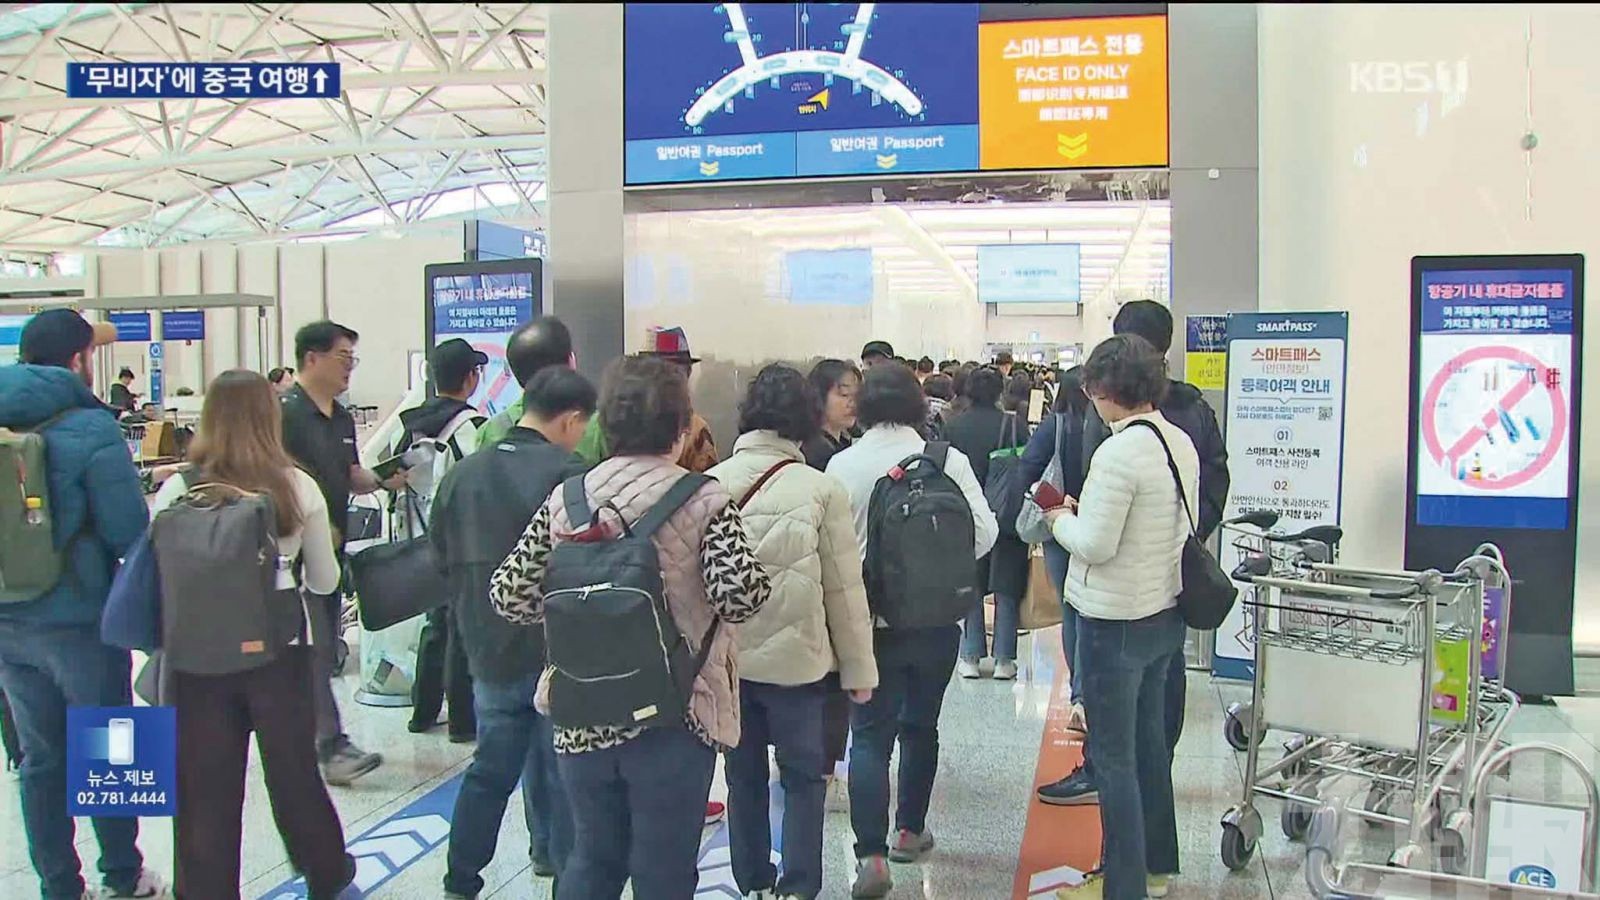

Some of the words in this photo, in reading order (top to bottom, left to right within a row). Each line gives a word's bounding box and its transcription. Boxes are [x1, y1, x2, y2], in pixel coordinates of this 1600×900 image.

[1003, 35, 1100, 59] 스마트패스
[1105, 33, 1144, 56] 전용
[1015, 66, 1059, 82] FACE
[1063, 65, 1081, 81] ID
[1083, 64, 1130, 80] ONLY
[830, 135, 879, 152] 일반여권
[884, 134, 944, 150] Passport
[656, 144, 701, 160] 일반여권
[706, 143, 764, 158] Passport
[1427, 284, 1466, 299] 항공기
[1469, 283, 1483, 298] 내
[1251, 347, 1321, 361] 스마트패스
[1241, 378, 1297, 394] 등록여객
[1301, 378, 1330, 394] 안내
[1276, 431, 1289, 441] 01
[1245, 446, 1287, 456] 스마트패스
[1287, 447, 1320, 459] 사전등록
[1273, 481, 1288, 491] 02
[1515, 870, 1551, 887] ACE
